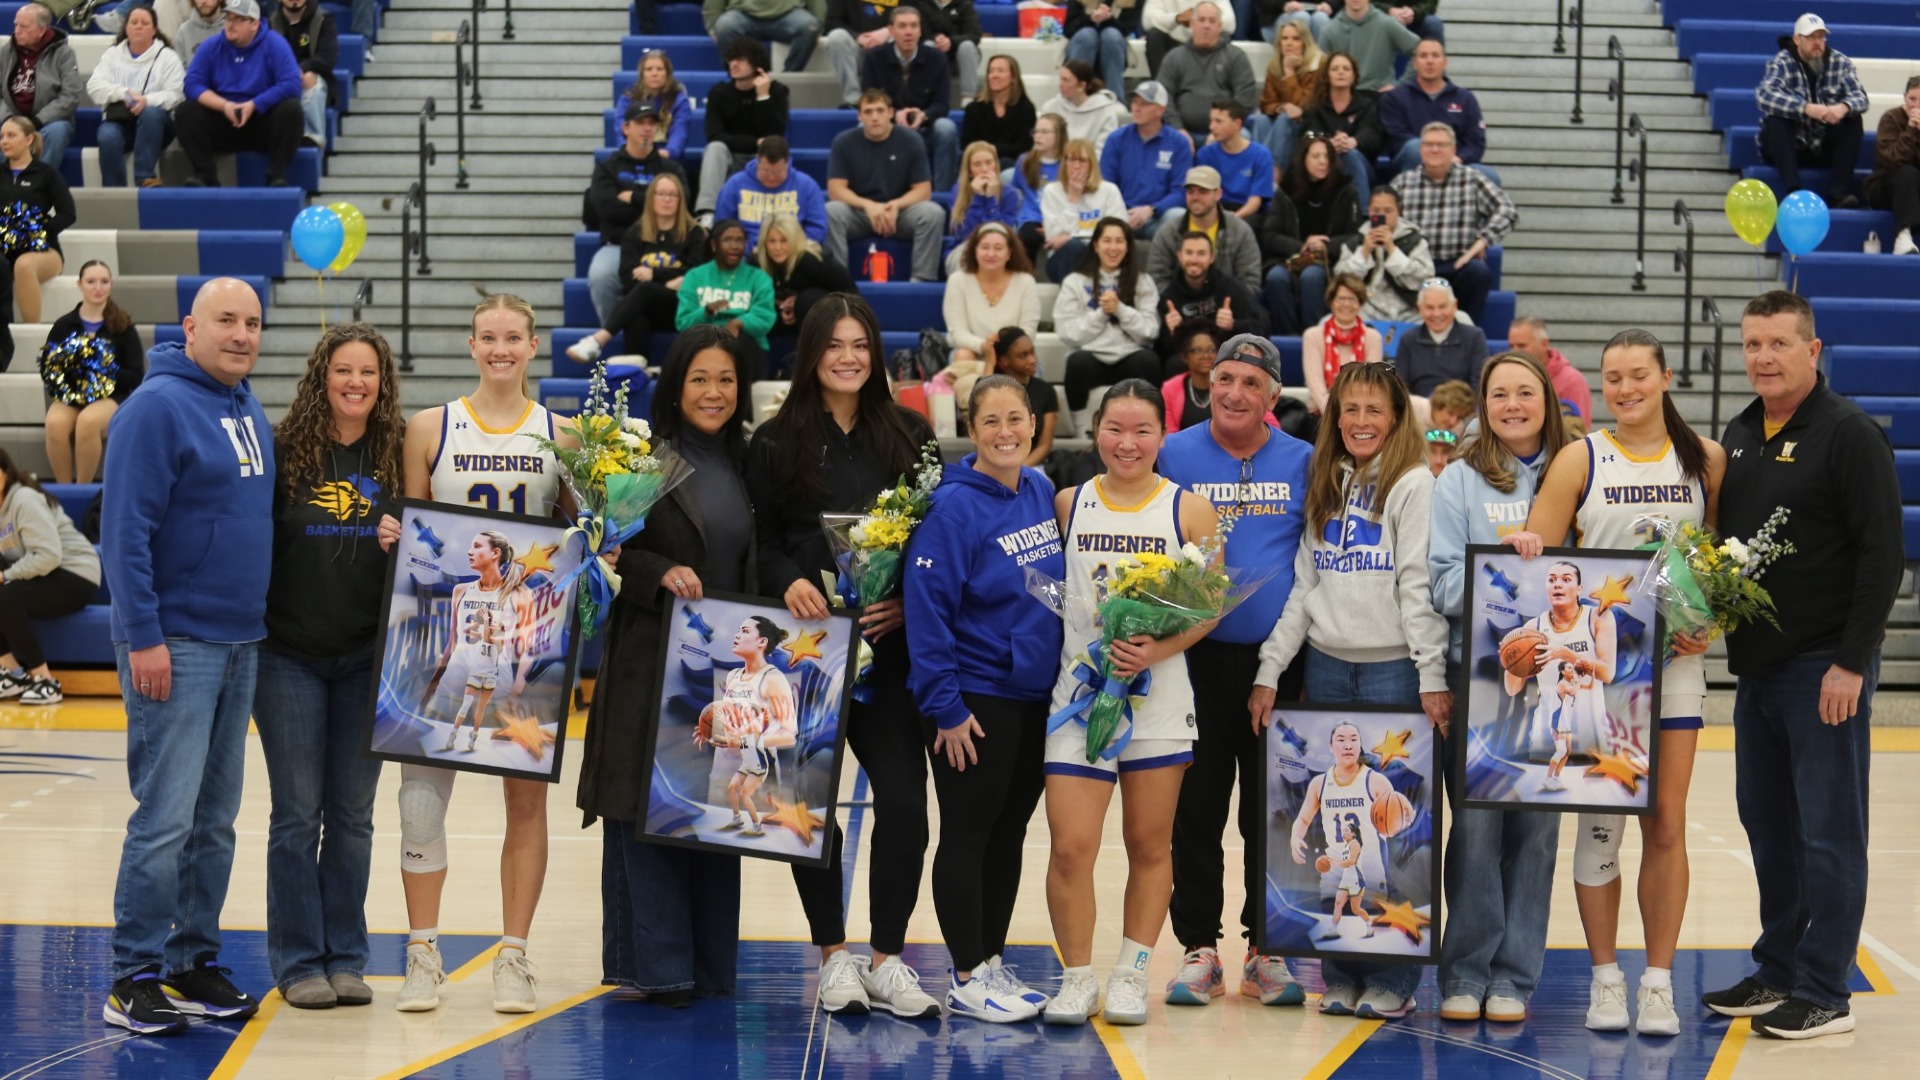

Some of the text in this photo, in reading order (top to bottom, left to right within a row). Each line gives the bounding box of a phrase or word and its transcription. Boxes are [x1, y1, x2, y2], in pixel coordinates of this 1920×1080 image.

[740, 189, 798, 209] WIDENER
[220, 416, 264, 477] W
[453, 454, 544, 475] WIDENER
[1192, 482, 1292, 502] WIDENER
[1603, 485, 1693, 505] WIDENER
[1216, 503, 1288, 517] SKETBALL
[1076, 533, 1168, 555] WIDENER
[463, 600, 505, 612] WIDENER
[480, 644, 492, 657] 31
[1325, 797, 1365, 809] WIDENER
